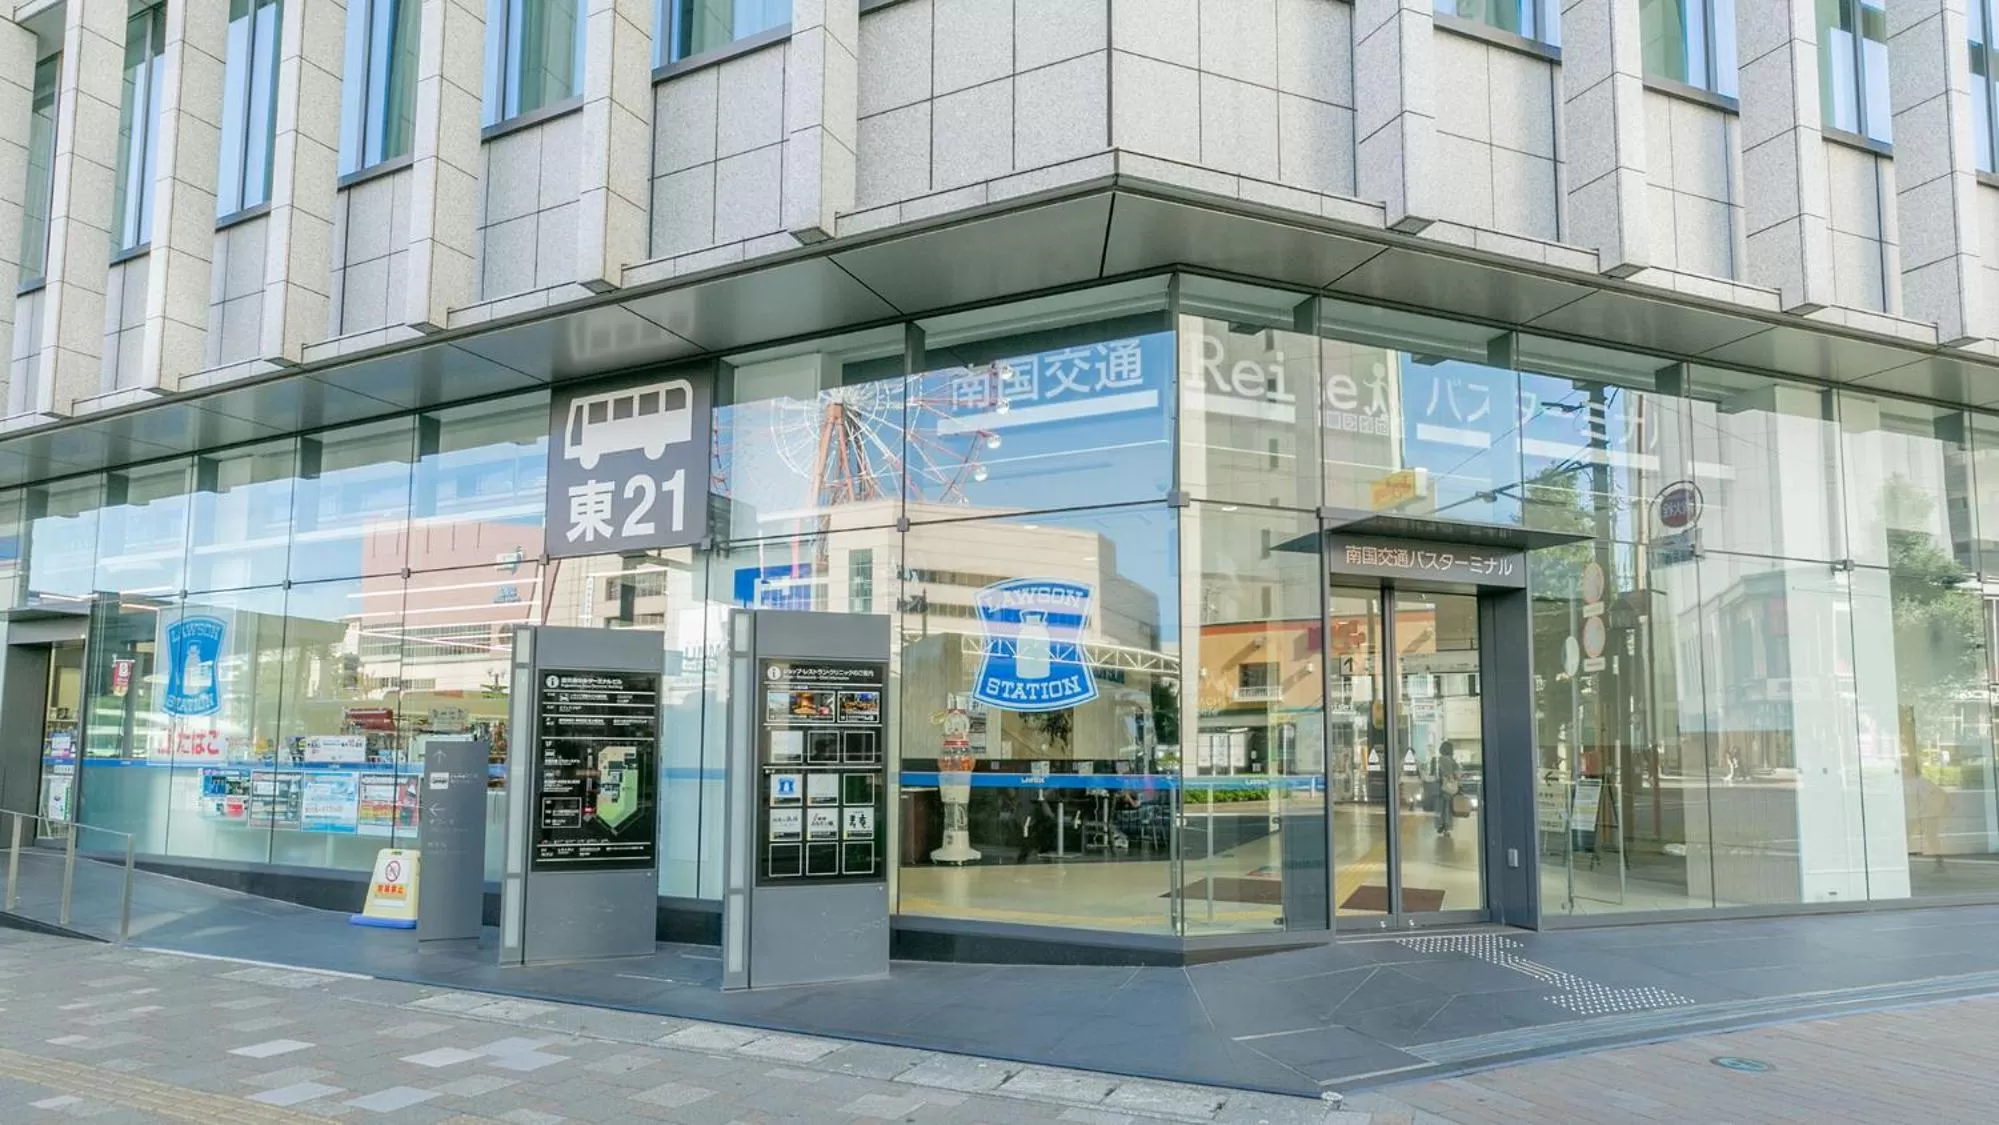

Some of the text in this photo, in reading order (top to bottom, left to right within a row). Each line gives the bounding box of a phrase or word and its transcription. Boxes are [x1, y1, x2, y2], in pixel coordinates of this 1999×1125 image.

[952, 338, 1145, 411] 南国交通
[565, 468, 686, 544] 東21
[1344, 545, 1514, 576] 南国交通バスターミナル
[981, 586, 1084, 614] LAWSON
[986, 674, 1083, 701] STATION
